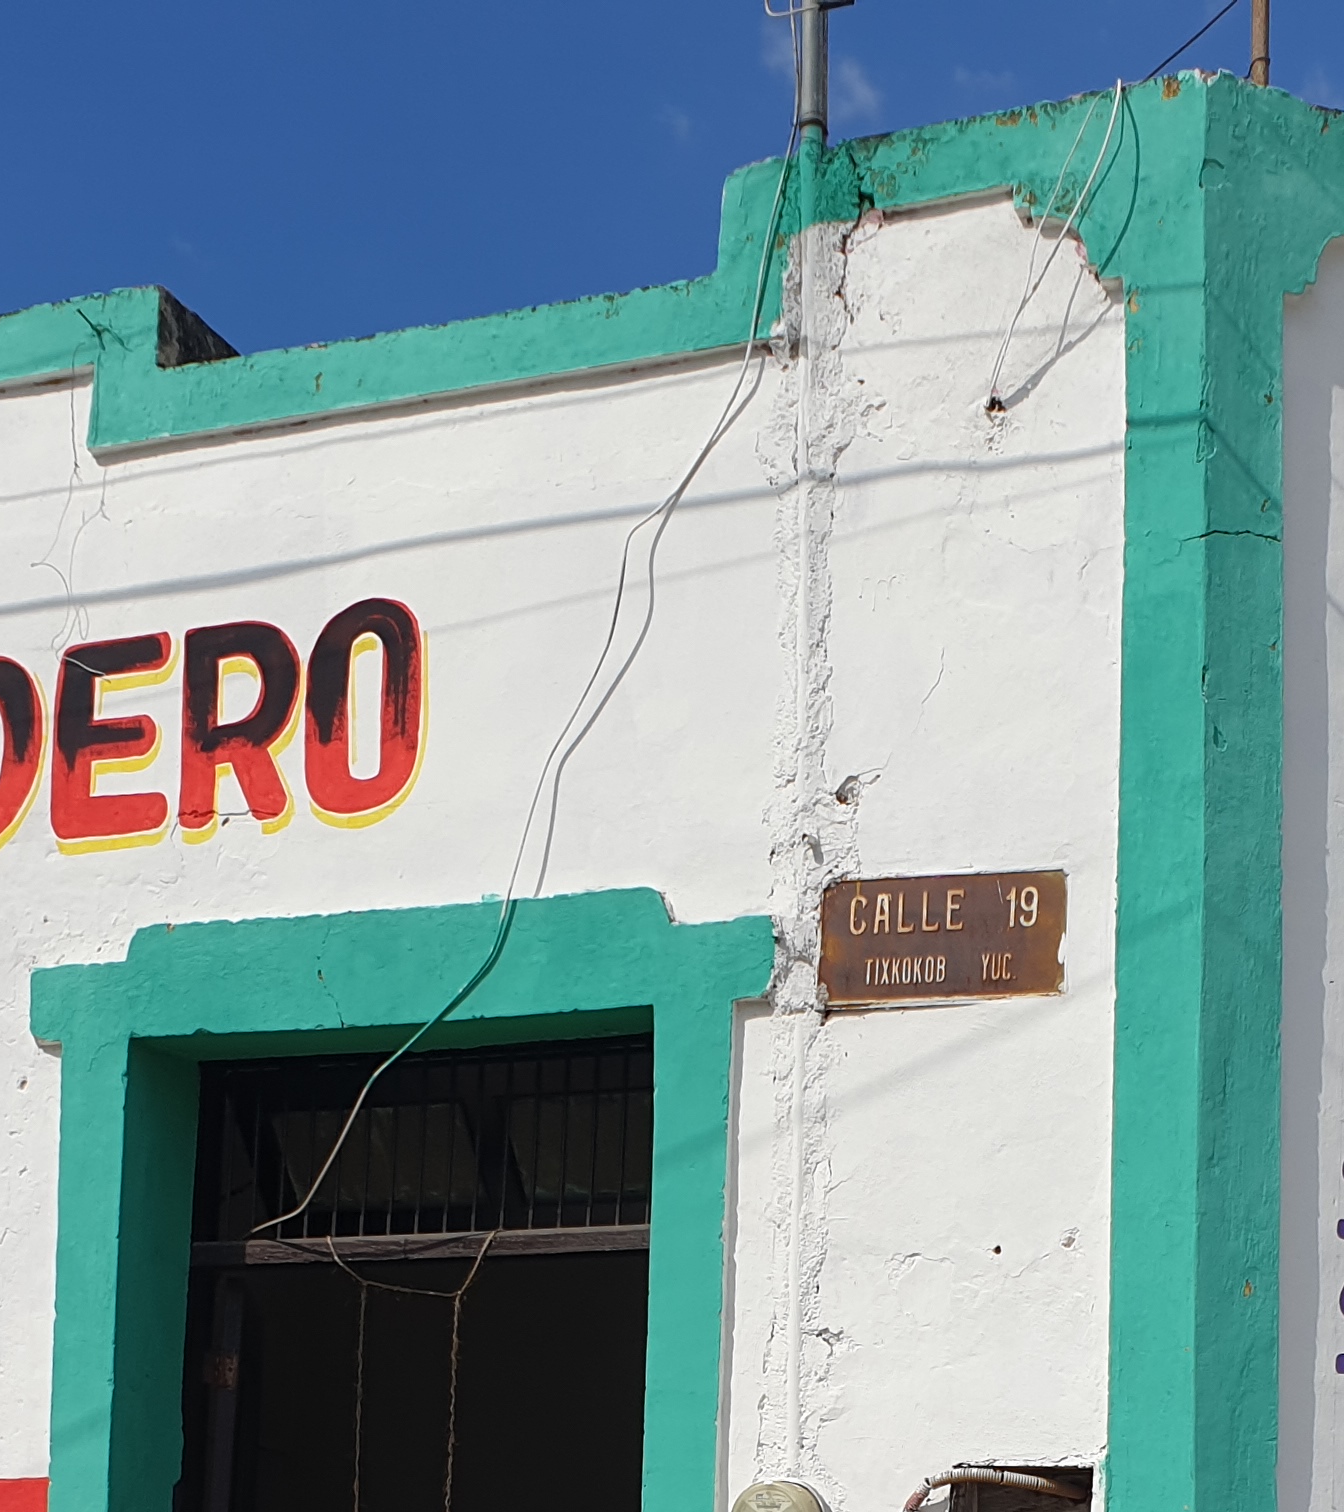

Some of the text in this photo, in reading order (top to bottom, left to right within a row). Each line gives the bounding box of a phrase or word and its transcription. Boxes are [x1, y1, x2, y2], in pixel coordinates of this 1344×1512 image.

[849, 885, 1039, 936] CALLE 19
[864, 953, 1017, 986] TIXKOKOB YUC.
